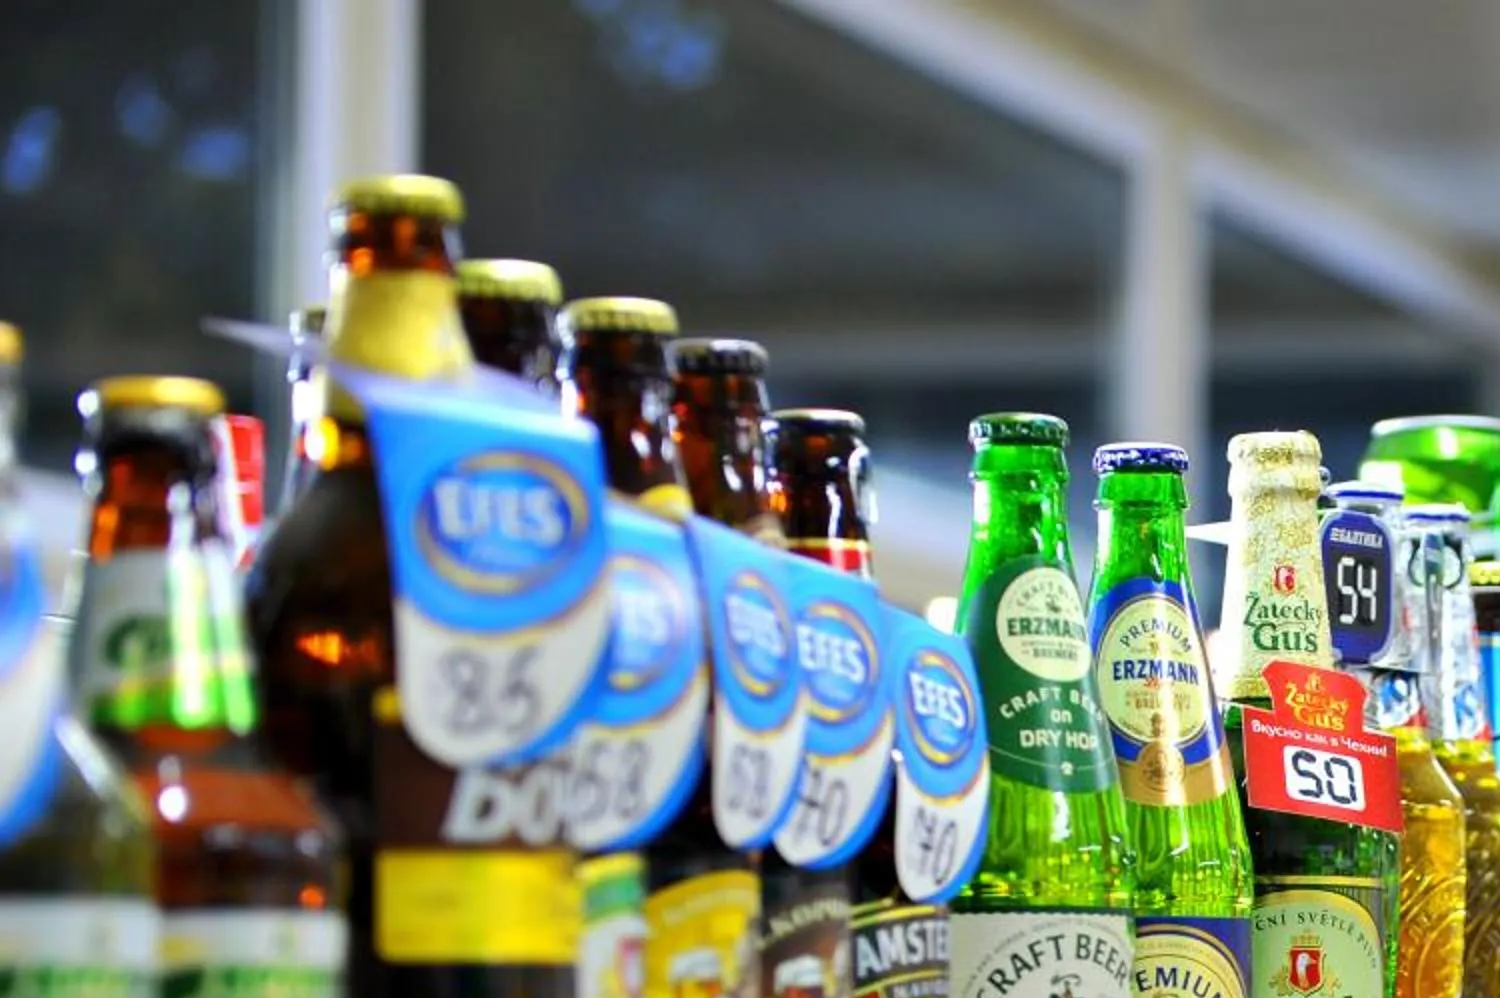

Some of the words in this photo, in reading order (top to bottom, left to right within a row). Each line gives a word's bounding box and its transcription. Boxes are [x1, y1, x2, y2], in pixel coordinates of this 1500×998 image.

[1337, 556, 1378, 625] 54
[797, 622, 866, 684] EFES
[1119, 617, 1192, 653] PREMIUM
[1113, 659, 1199, 686] ERZMANN
[910, 671, 965, 729] EFES
[999, 687, 1061, 719] CRAFT
[1050, 708, 1072, 724] on
[1019, 728, 1061, 748] DRY
[1251, 719, 1302, 740] Вкусно
[1305, 731, 1329, 745] как
[1291, 749, 1358, 804] 50
[1254, 909, 1287, 931] ČNÍ
[857, 920, 949, 978] AMSTE
[1075, 932, 1129, 988] BEER
